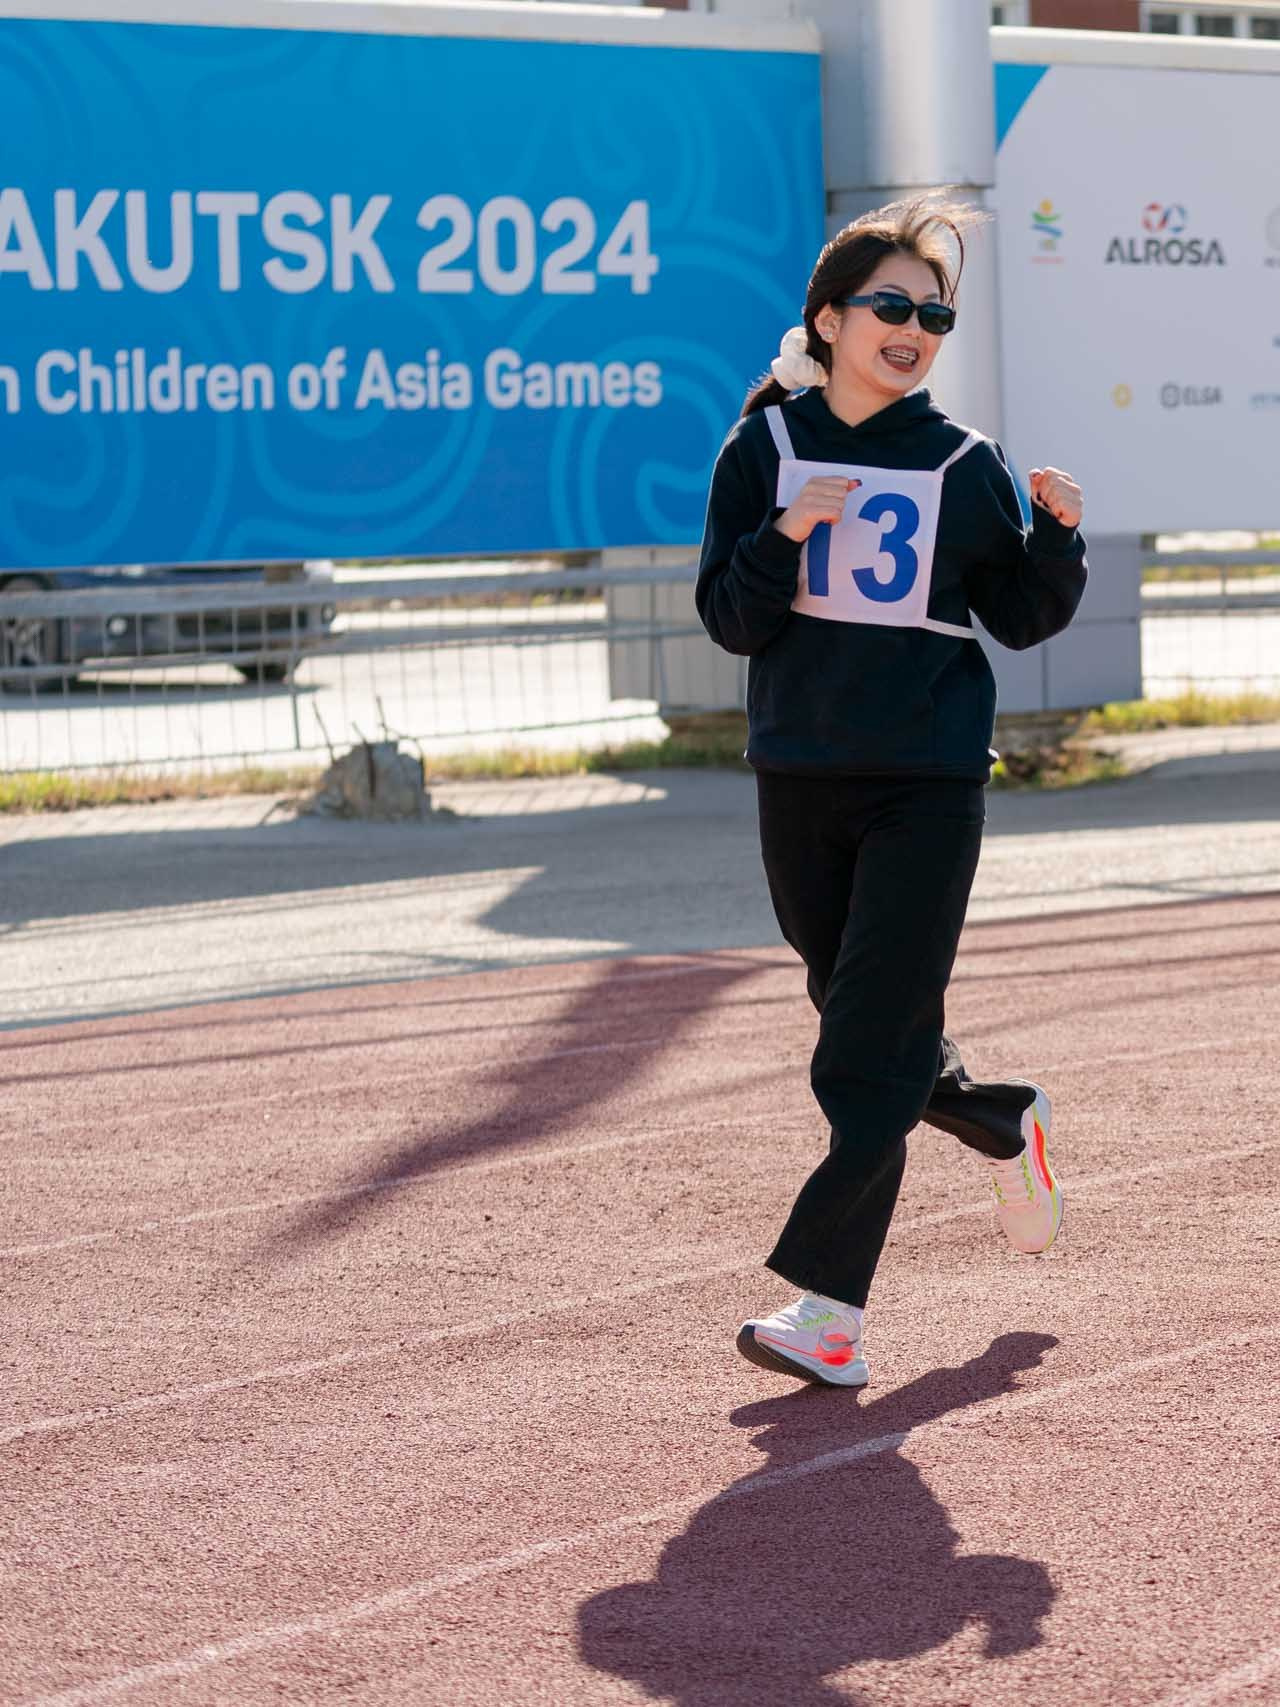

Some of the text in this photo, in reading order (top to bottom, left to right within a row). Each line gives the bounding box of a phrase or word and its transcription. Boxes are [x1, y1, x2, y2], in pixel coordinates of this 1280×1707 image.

[0, 187, 660, 295] AKUTSK 2024
[1105, 238, 1225, 266] ALROSA
[35, 348, 274, 414] Children
[287, 347, 346, 411] of
[354, 348, 472, 410] Asia
[484, 348, 663, 408] Games
[807, 491, 920, 603] 13
